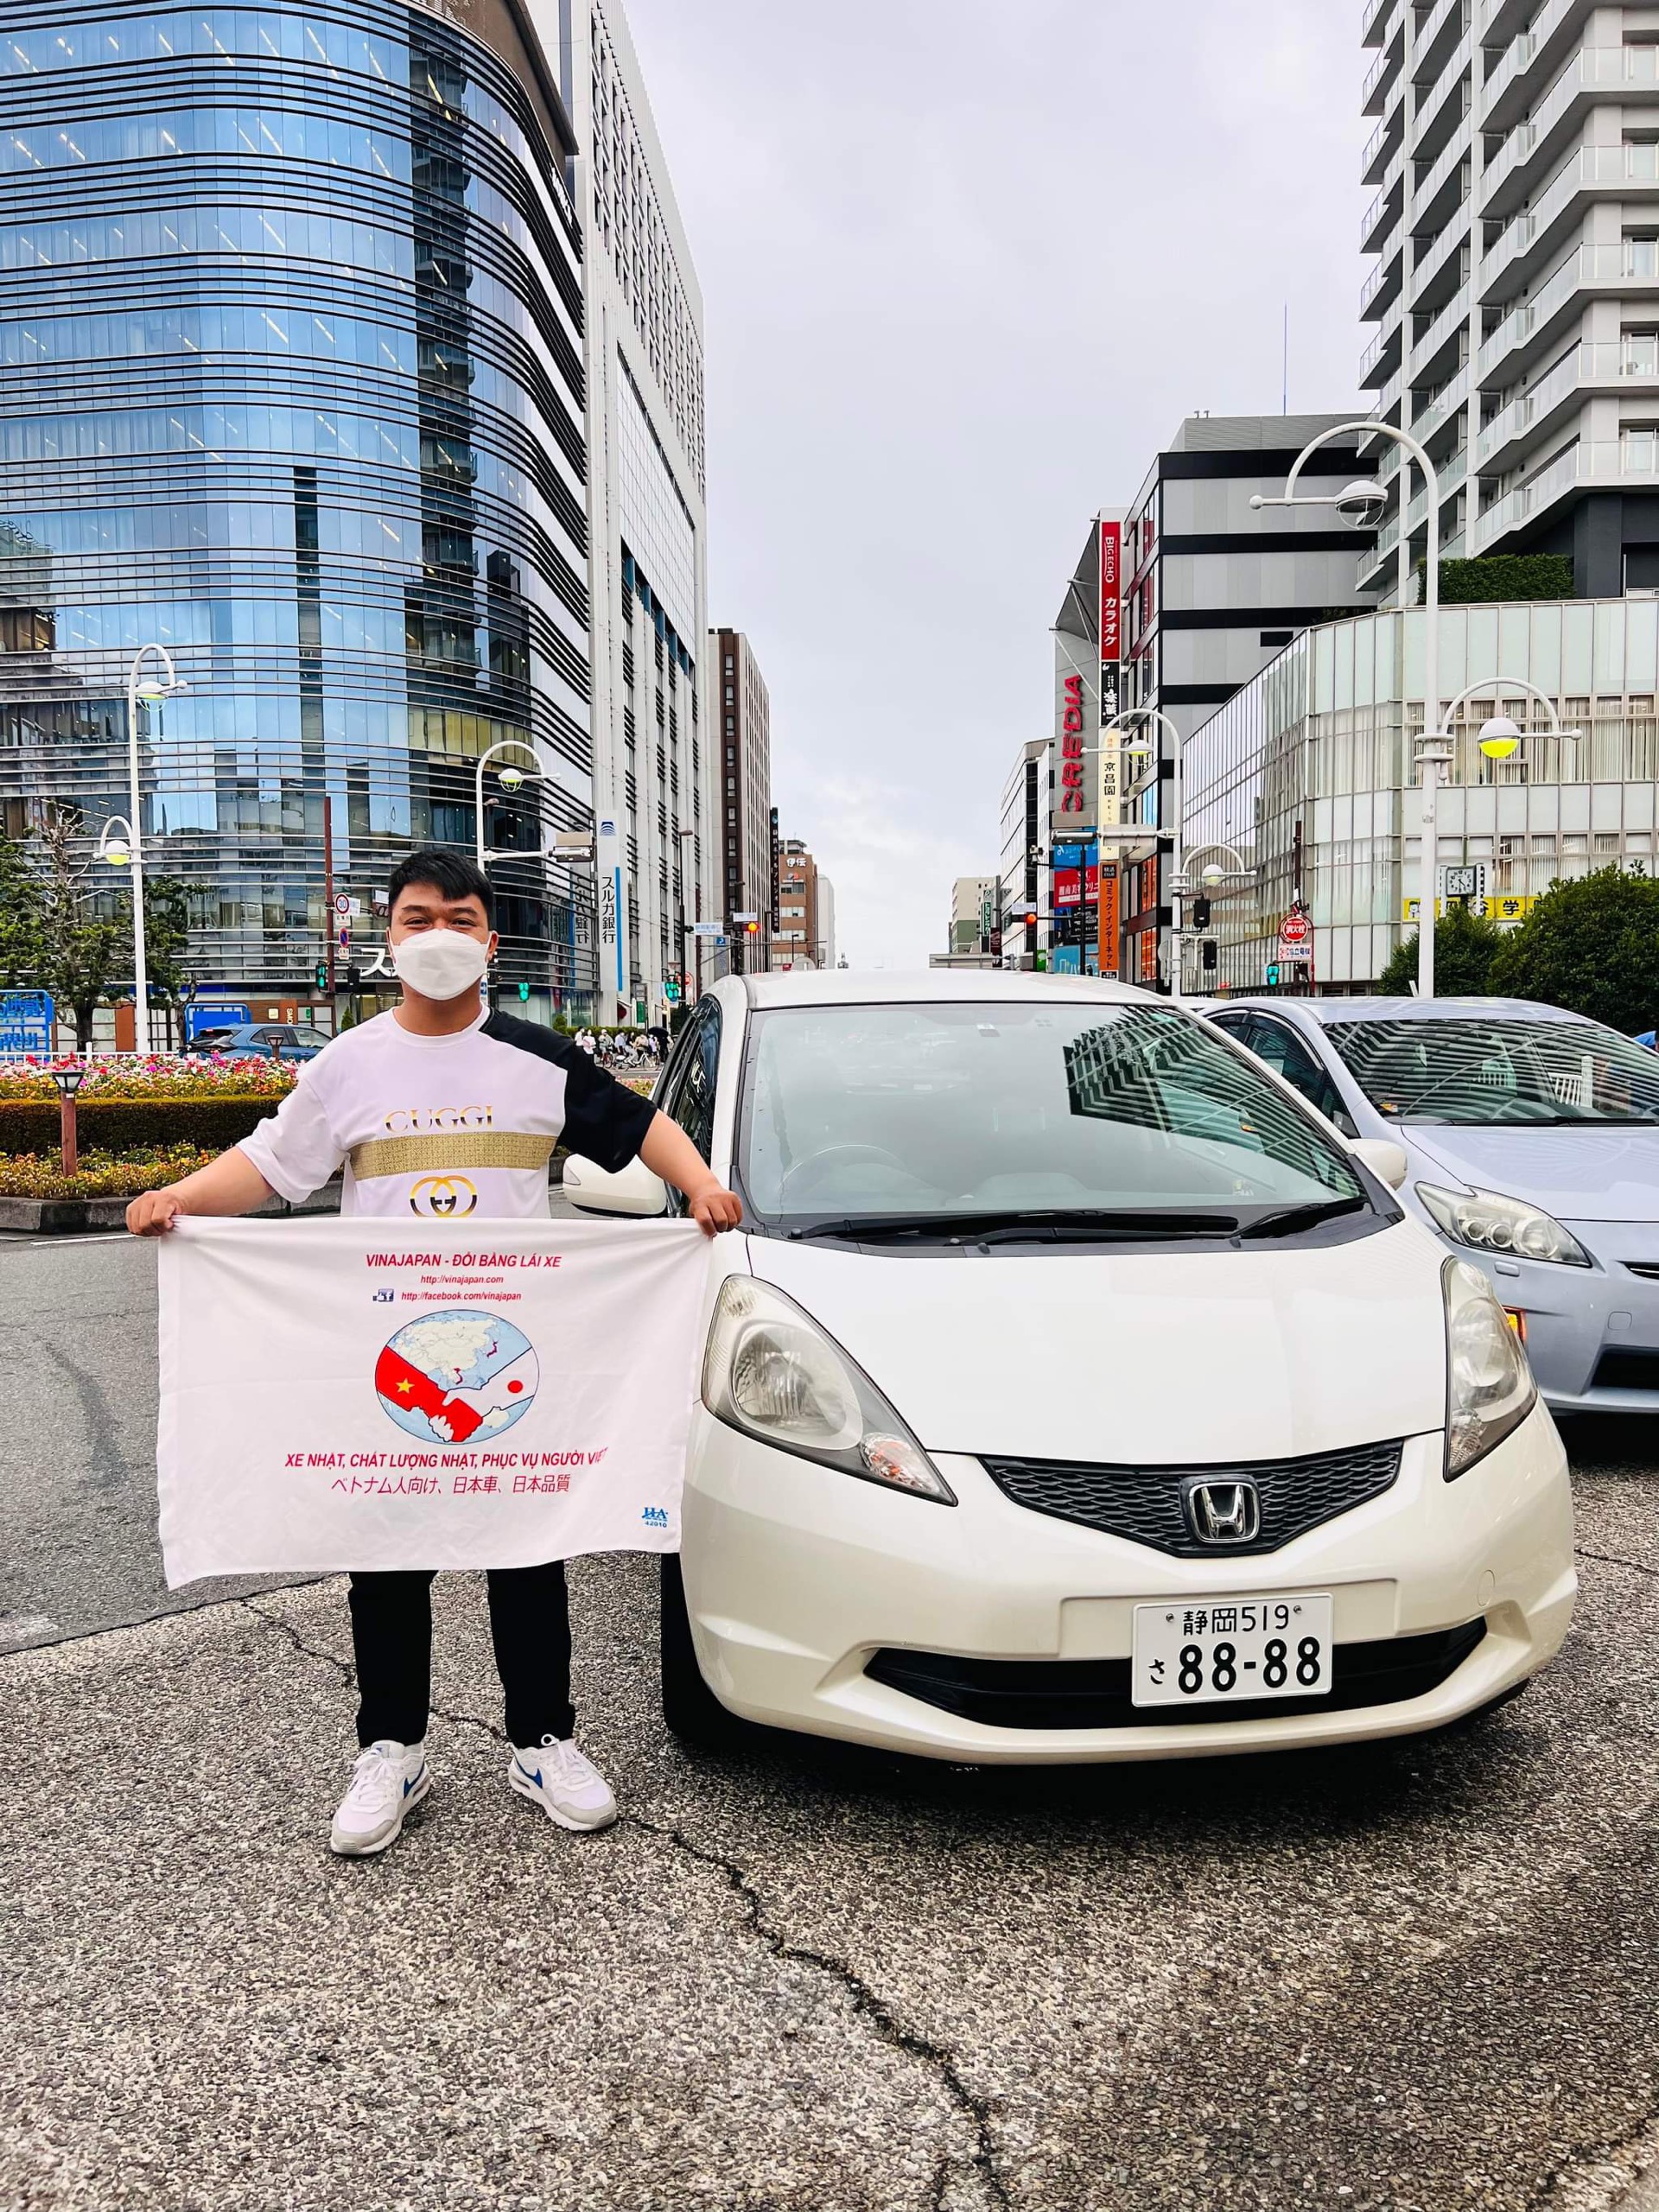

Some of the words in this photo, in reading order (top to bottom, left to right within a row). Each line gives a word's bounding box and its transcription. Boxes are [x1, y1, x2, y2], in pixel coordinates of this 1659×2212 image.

[1104, 597, 1117, 648] カラオケ
[338, 899, 346, 909] 30
[601, 876, 616, 944] スルガ銀行
[360, 947, 397, 977] ス
[385, 1105, 493, 1134] CUGGI
[365, 1254, 442, 1268] VINAJAPAN
[520, 1252, 541, 1268] LÁI
[543, 1255, 563, 1268] XE
[420, 1274, 504, 1286] http://vinajapan.com
[401, 1291, 522, 1302] http://facebook.com/vinajapan
[285, 1453, 304, 1467] XE
[481, 1453, 518, 1469] PHỤC
[520, 1453, 539, 1469] VỤ
[330, 1474, 572, 1495] ベトナム人向け、日本車、日本品質
[1147, 1658, 1166, 1686] さ
[1178, 1636, 1321, 1694] 88-88
